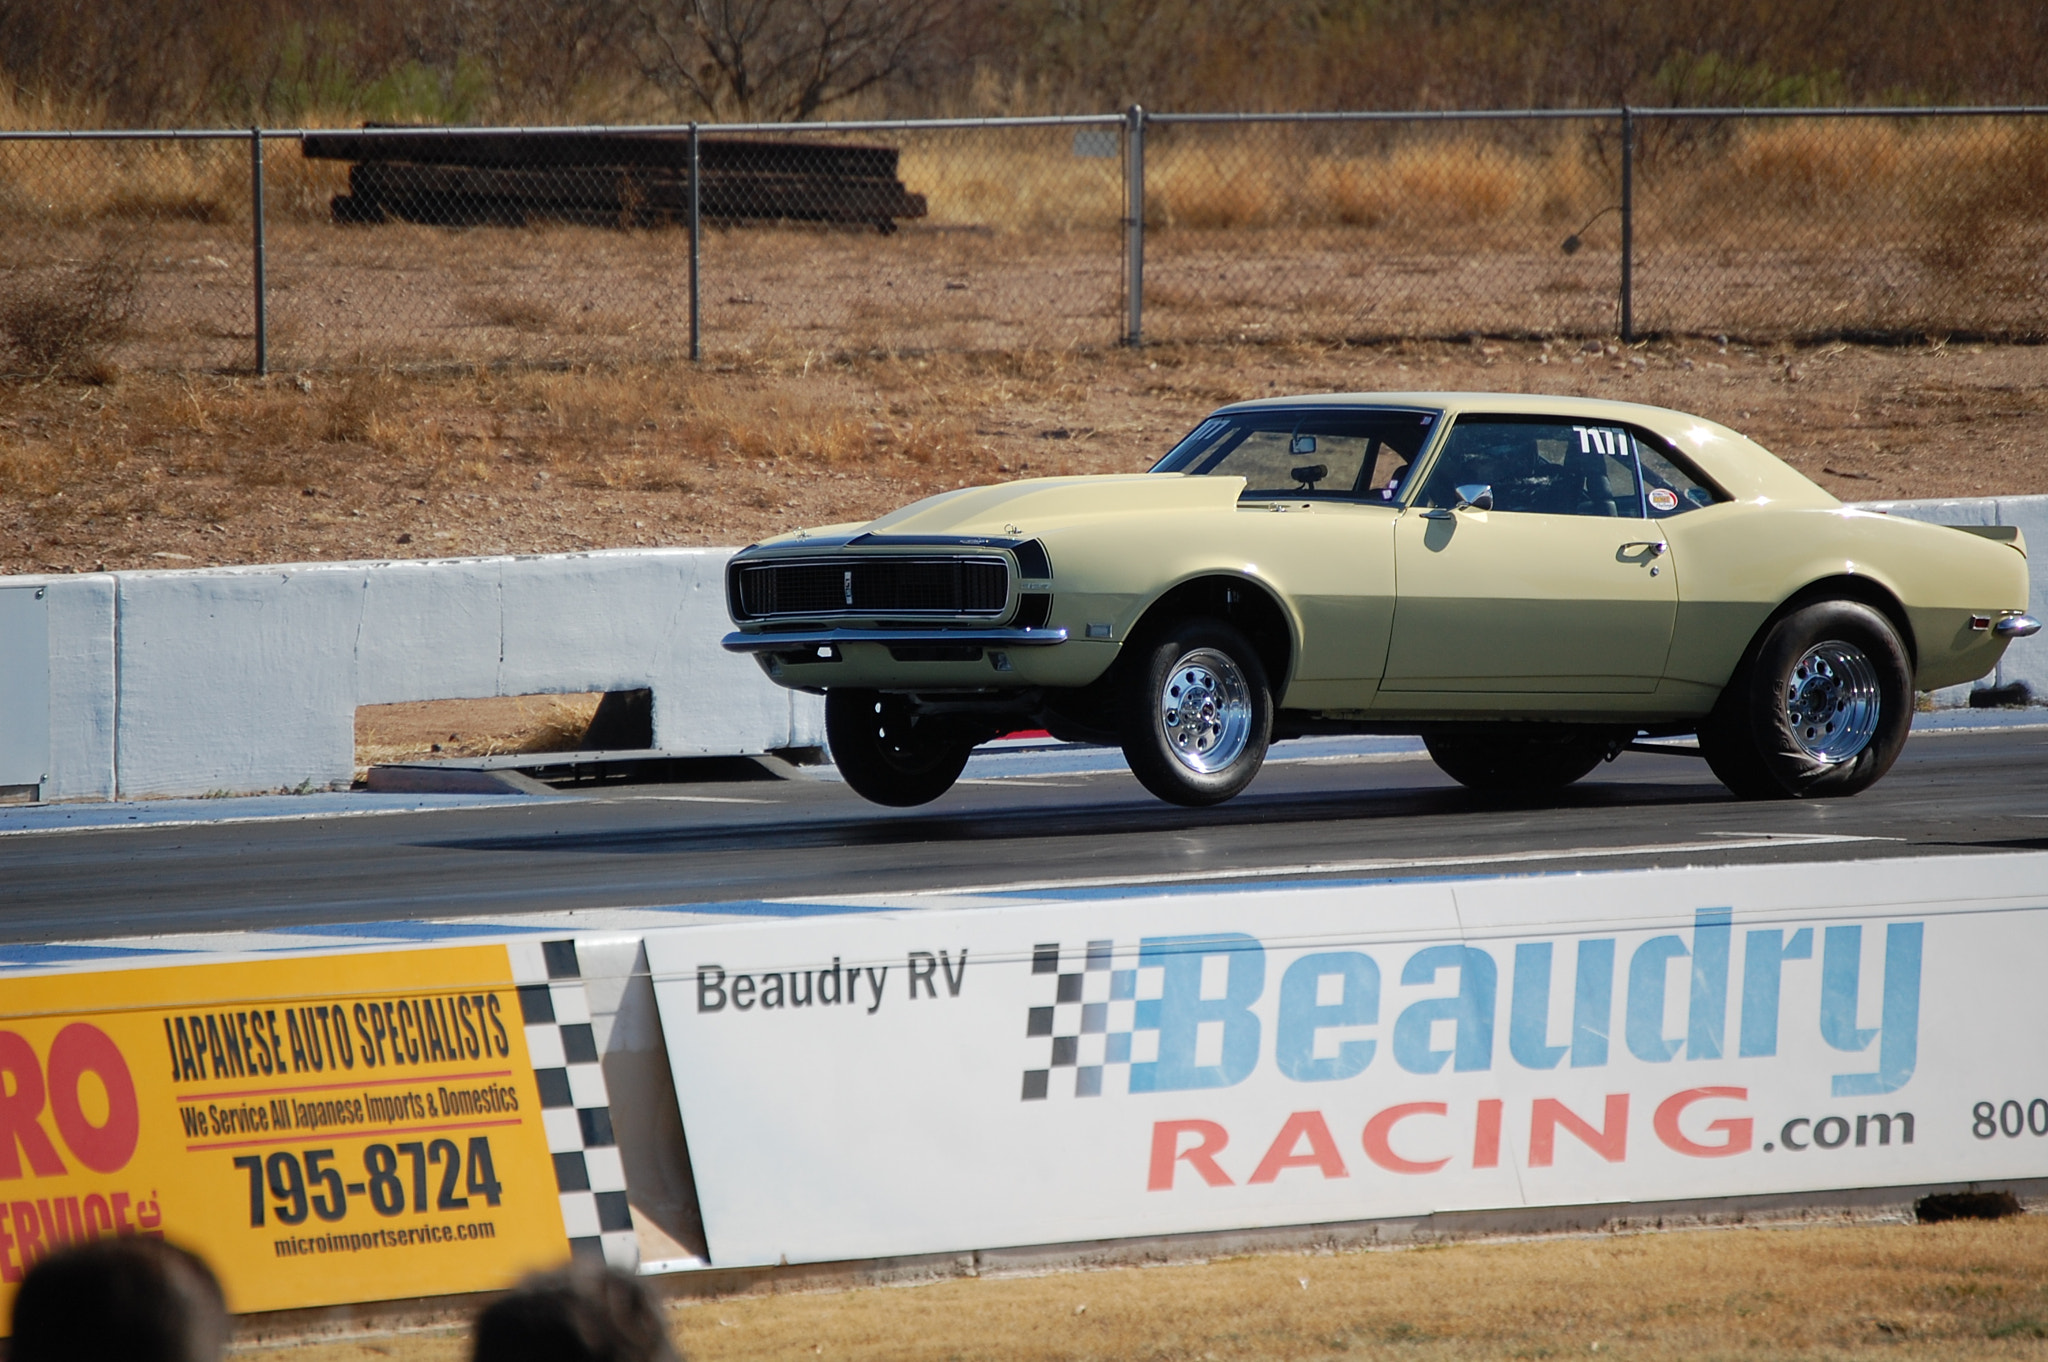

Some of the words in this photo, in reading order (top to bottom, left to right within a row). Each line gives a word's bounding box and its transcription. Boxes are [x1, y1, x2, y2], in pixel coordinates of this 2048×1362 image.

[697, 956, 888, 1015] Beaudry
[907, 948, 968, 1000] RV
[1129, 907, 1925, 1097] Beaudry
[163, 1010, 288, 1083] JAPANESE
[285, 1003, 355, 1073] AUTO
[353, 992, 510, 1069] SPECIALISTS
[179, 1106, 209, 1138] We
[208, 1102, 269, 1136] Service
[269, 1098, 292, 1131] All
[291, 1098, 364, 1131] Japanese
[364, 1091, 426, 1125] Imports
[425, 1092, 439, 1118] &
[438, 1083, 520, 1117] Domestics
[1972, 1098, 2048, 1140] 800
[233, 1136, 503, 1229] 795-8724
[273, 1221, 496, 1258] microimportservice.com
